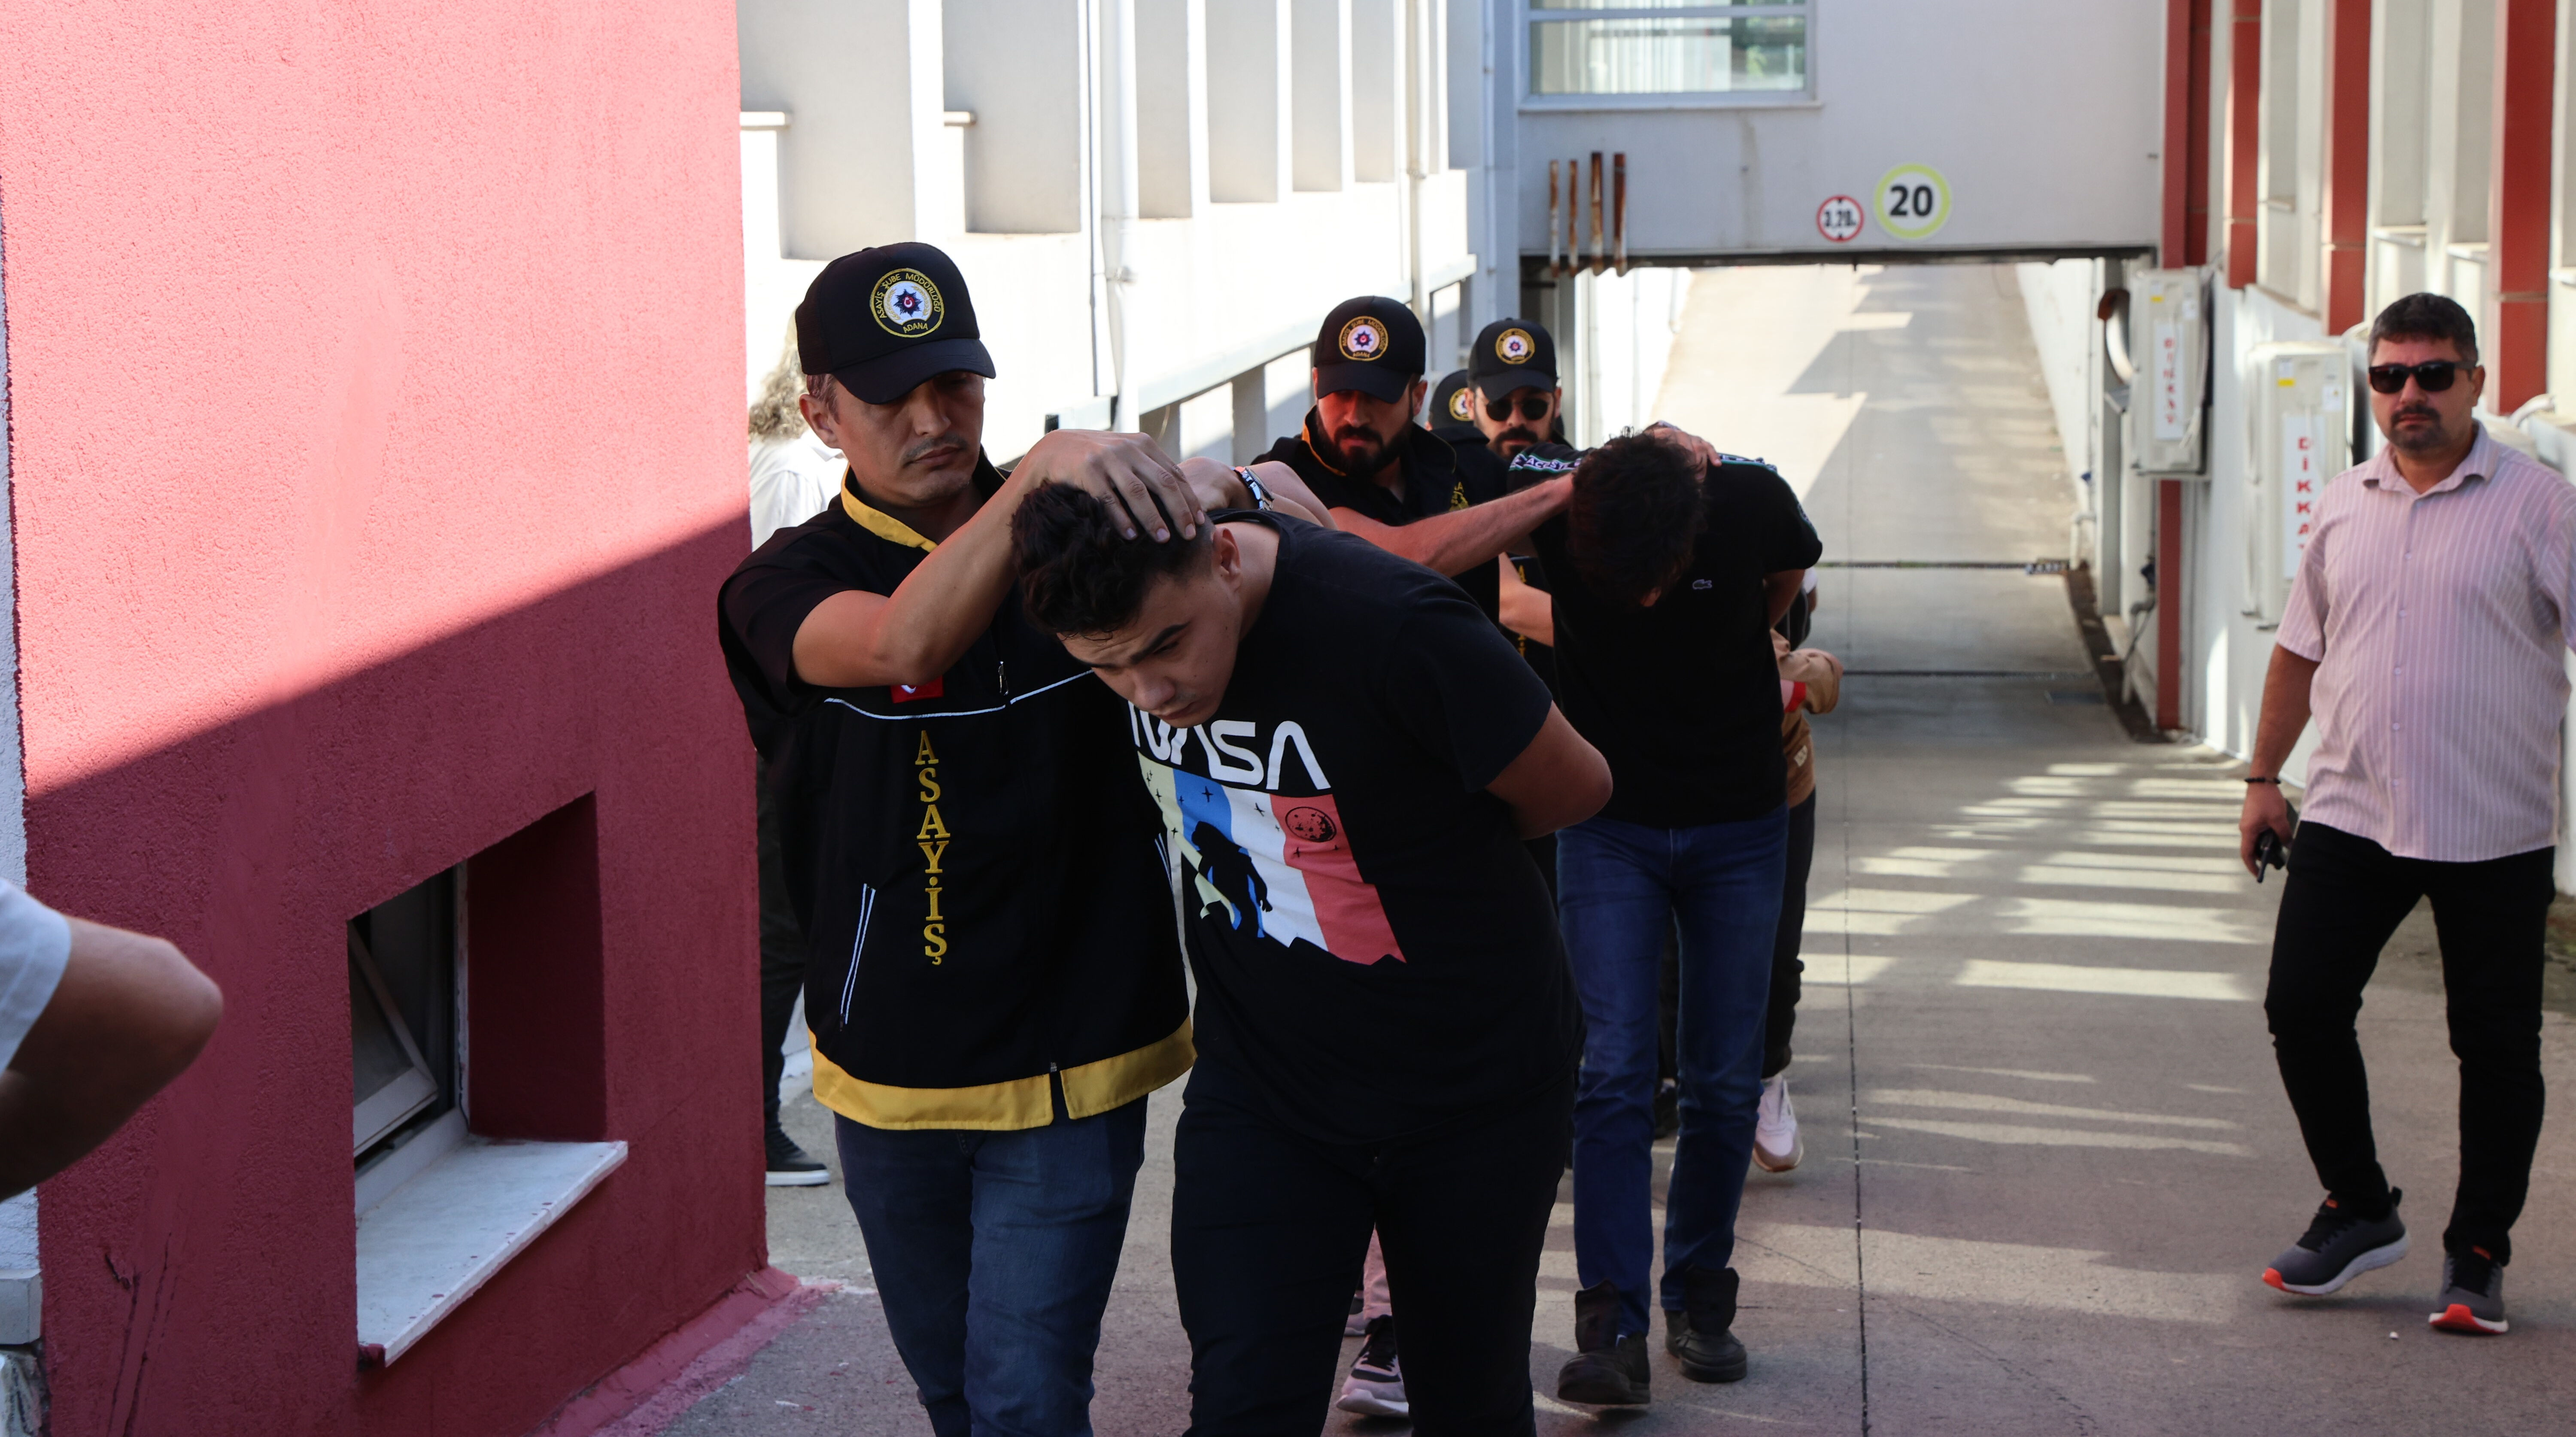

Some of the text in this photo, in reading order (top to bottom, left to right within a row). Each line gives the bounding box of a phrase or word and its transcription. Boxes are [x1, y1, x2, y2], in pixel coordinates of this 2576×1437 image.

[1890, 185, 1933, 217] 20
[875, 292, 887, 318] ASAYİŞ
[882, 273, 901, 290] ŞUBE
[903, 322, 928, 334] ADANA
[2297, 436, 2312, 549] DİKKA
[1128, 700, 1331, 790] NASA
[914, 730, 951, 966] ASAYİŞ
